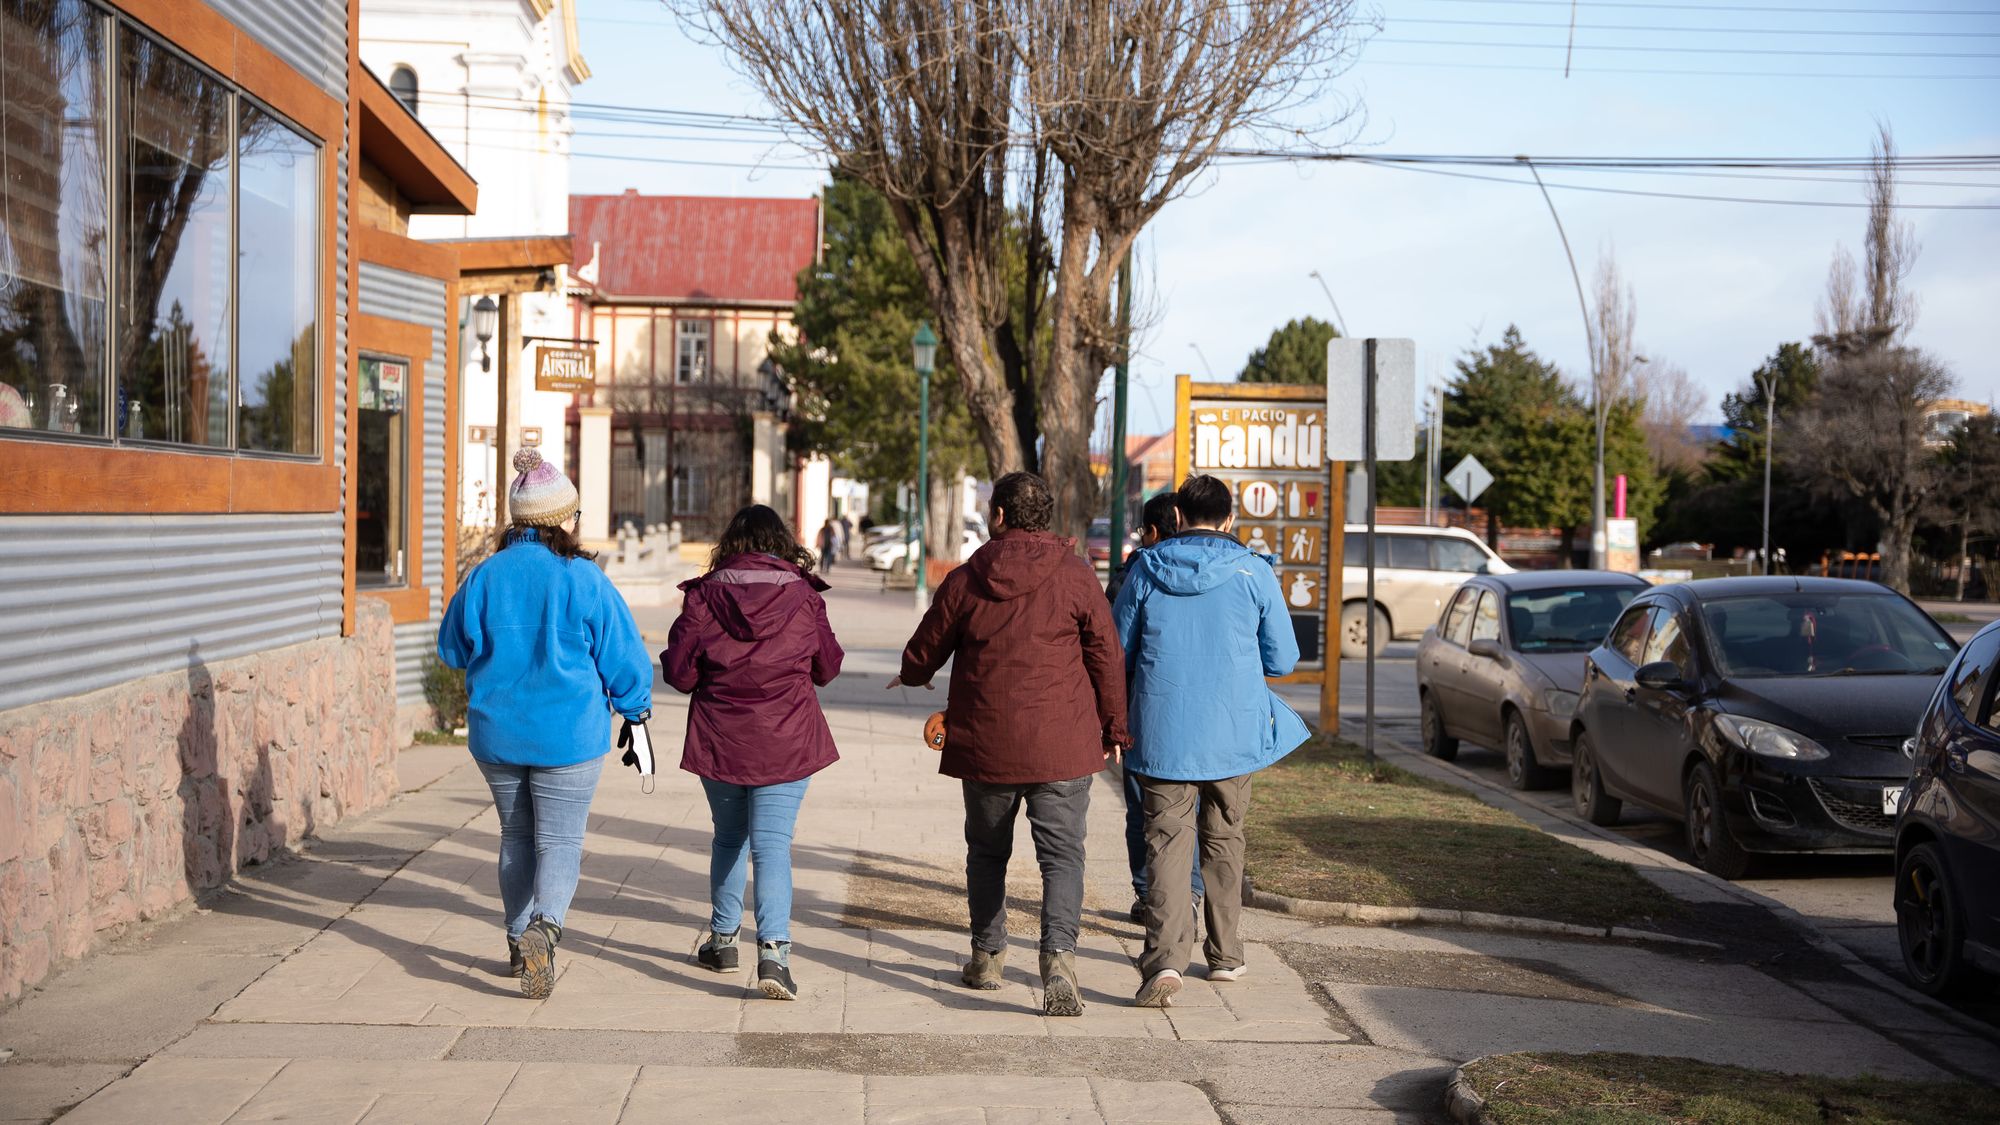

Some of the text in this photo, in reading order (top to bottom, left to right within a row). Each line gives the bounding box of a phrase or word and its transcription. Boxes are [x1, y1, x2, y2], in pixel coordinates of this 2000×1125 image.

[541, 353, 593, 379] AUSTRAL
[1195, 412, 1321, 468] ñandú
[1886, 790, 1904, 806] K
